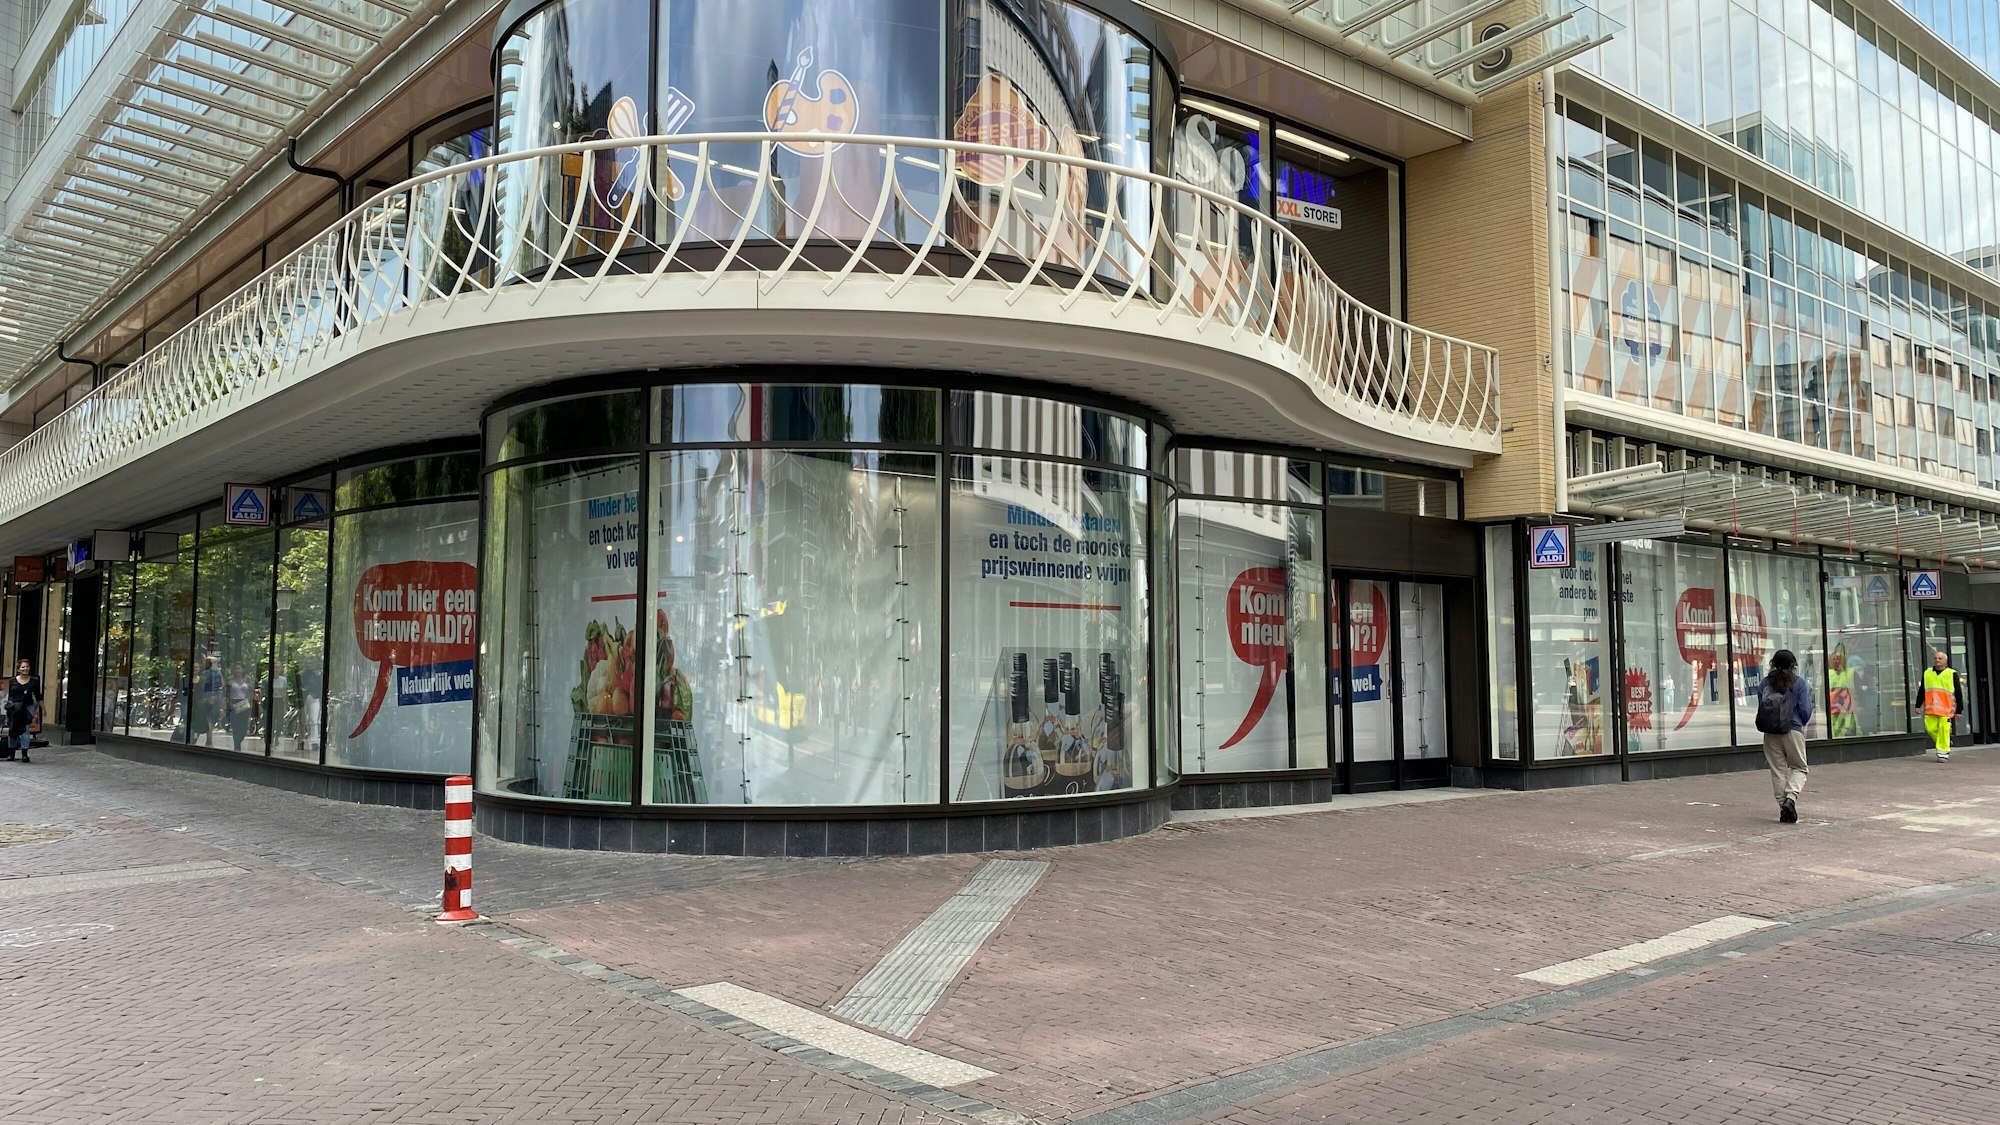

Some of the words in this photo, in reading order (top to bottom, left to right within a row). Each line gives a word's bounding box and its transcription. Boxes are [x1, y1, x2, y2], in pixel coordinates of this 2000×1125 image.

[1278, 200, 1301, 218] XXL
[1303, 206, 1338, 224] STORE!
[235, 512, 262, 520] ALDI
[588, 496, 621, 519] Minder
[589, 528, 600, 546] en
[603, 521, 623, 543] toch
[989, 532, 1008, 550] en
[1014, 530, 1048, 552] toch
[1053, 533, 1072, 553] de
[606, 549, 620, 569] vol
[981, 556, 1092, 579] prijswinnende
[1539, 554, 1563, 562] ALDI
[363, 584, 403, 612] Komt
[408, 583, 439, 612] hier
[444, 589, 476, 613] een
[1239, 585, 1285, 616] Kom
[1559, 585, 1586, 600] andere
[1682, 602, 1713, 628] Komt
[364, 613, 420, 643] nieuwe
[1241, 617, 1285, 646] nieu
[402, 671, 451, 695] Natuurlijk
[1352, 674, 1376, 692] wel.
[1630, 686, 1646, 699] BEST
[1628, 701, 1649, 713] GETEST
